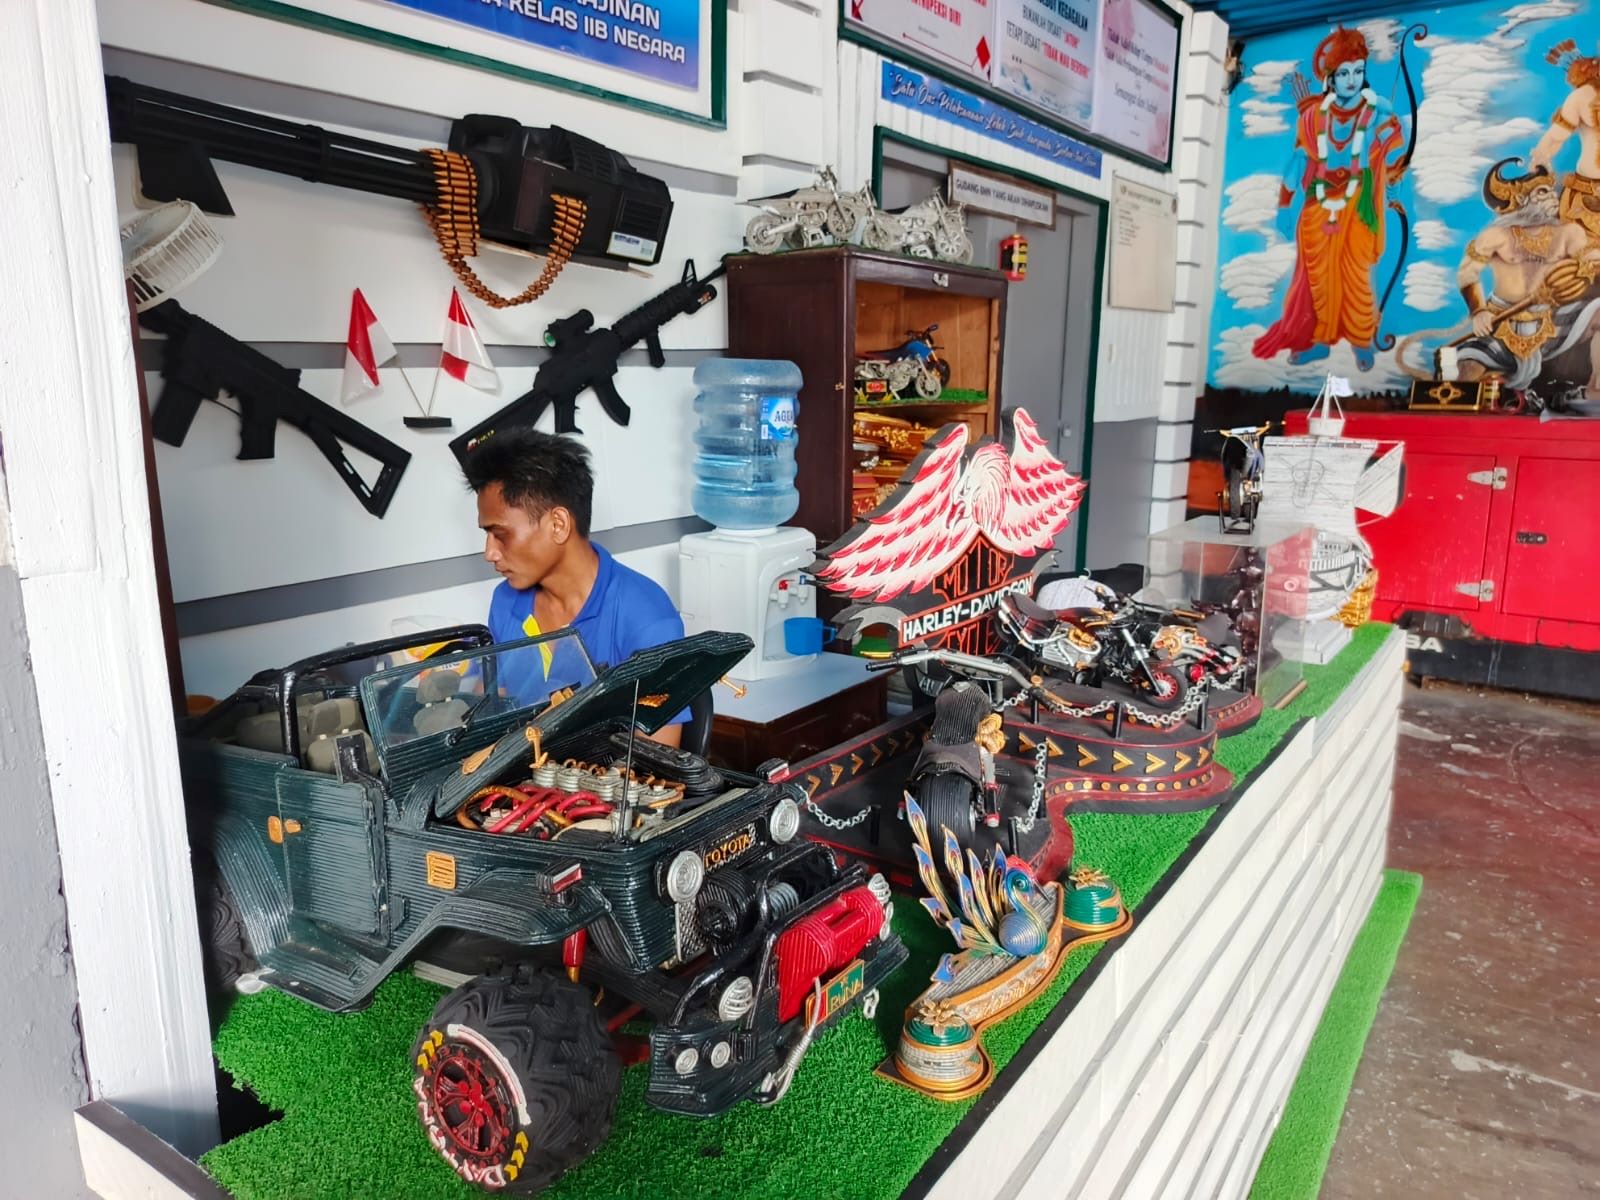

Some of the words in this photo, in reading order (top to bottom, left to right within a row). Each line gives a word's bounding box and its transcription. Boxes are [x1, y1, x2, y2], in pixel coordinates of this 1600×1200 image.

[577, 0, 660, 30] AJINAN
[584, 16, 609, 40] IIB
[613, 25, 685, 64] NEGARA
[704, 833, 752, 869] TOYOTA
